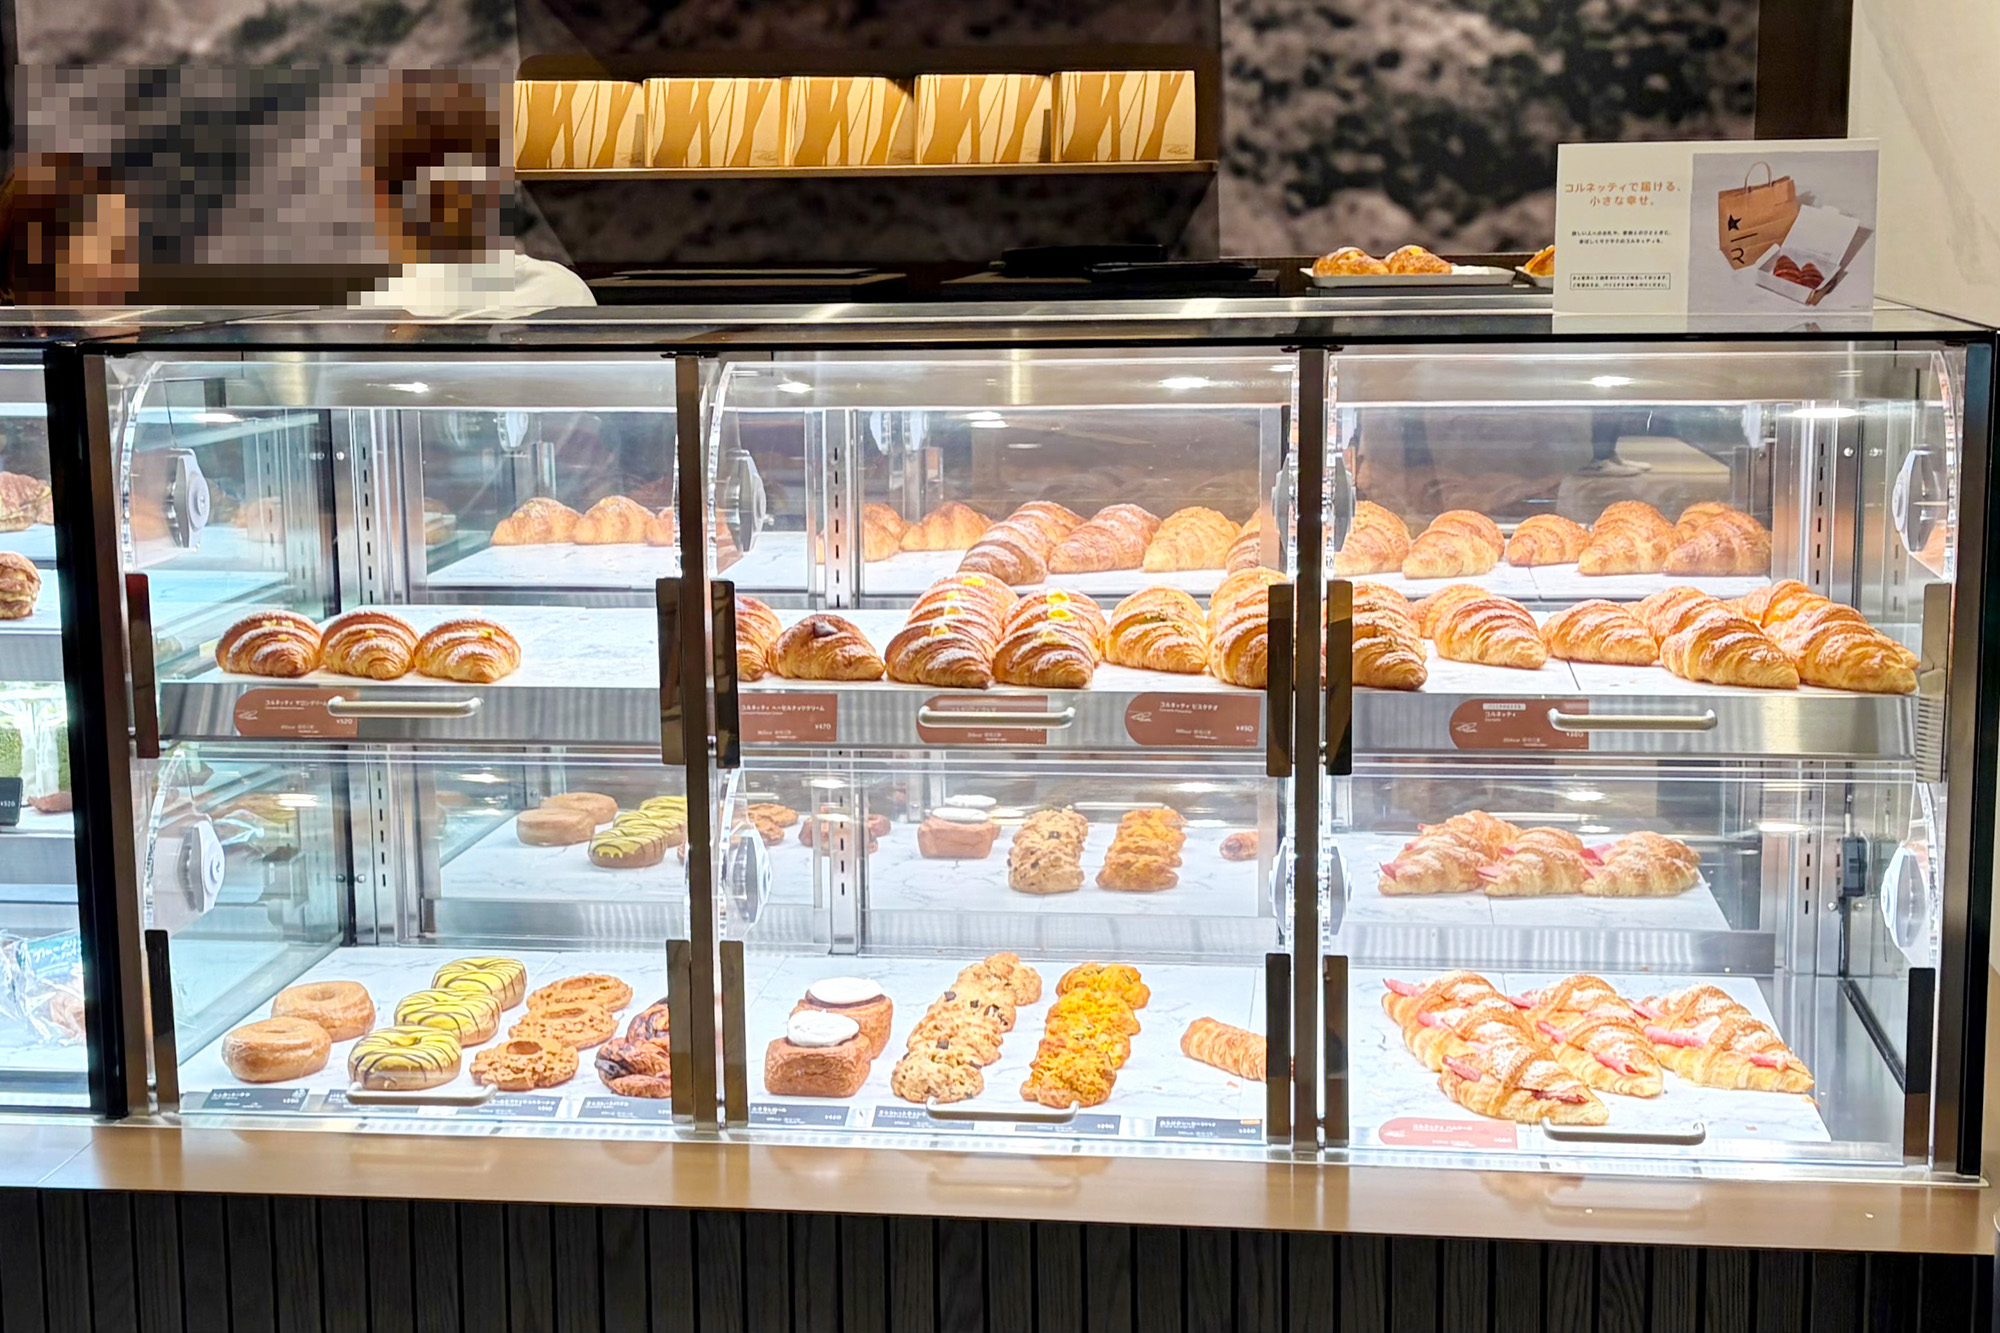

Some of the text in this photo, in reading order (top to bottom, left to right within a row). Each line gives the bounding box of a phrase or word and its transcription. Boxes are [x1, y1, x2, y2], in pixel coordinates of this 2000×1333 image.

[1590, 195, 1654, 207] 小さな幸せ。
